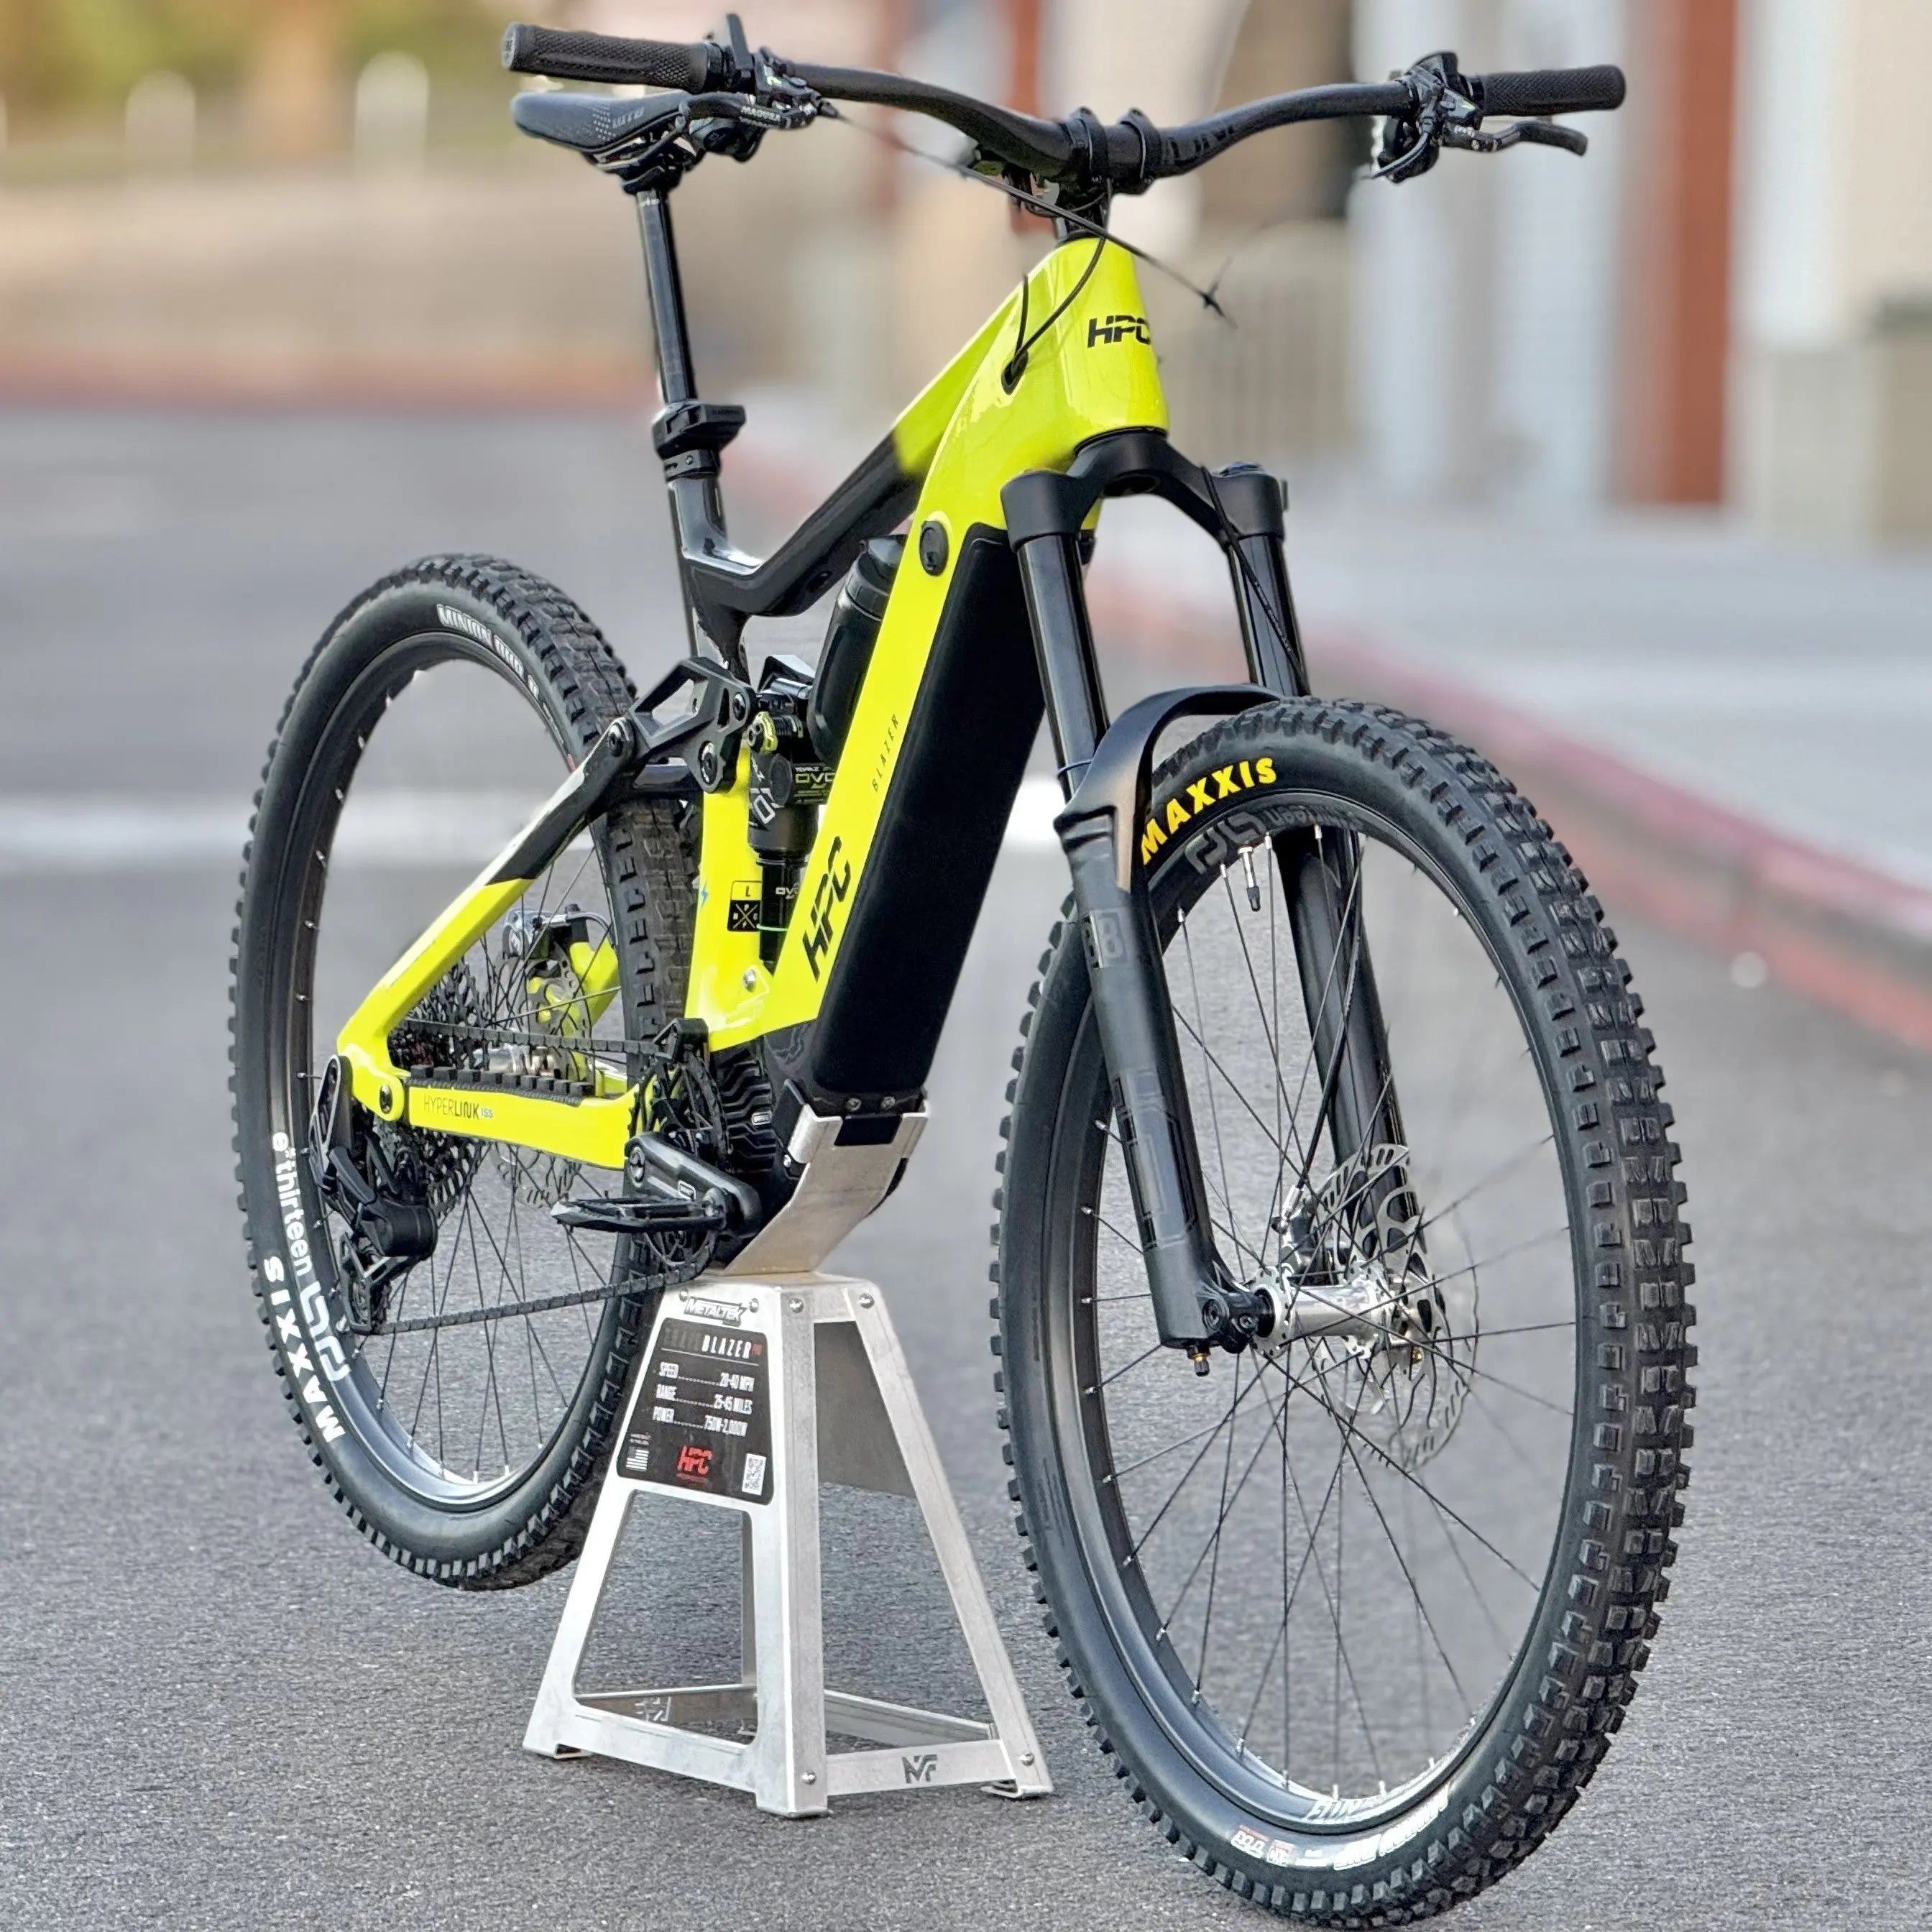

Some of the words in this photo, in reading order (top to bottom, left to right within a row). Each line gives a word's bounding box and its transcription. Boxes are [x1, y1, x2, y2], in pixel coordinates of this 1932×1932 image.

[1087, 315, 1151, 348] HPC
[871, 714, 898, 792] BLAZER
[1141, 757, 1277, 865] MAXXIS
[802, 835, 852, 983] HPC
[423, 1094, 480, 1120] HYPERLINK
[684, 1297, 747, 1325] METALTEK
[264, 1255, 345, 1443] MAXXIS
[677, 1445, 712, 1475] HPC
